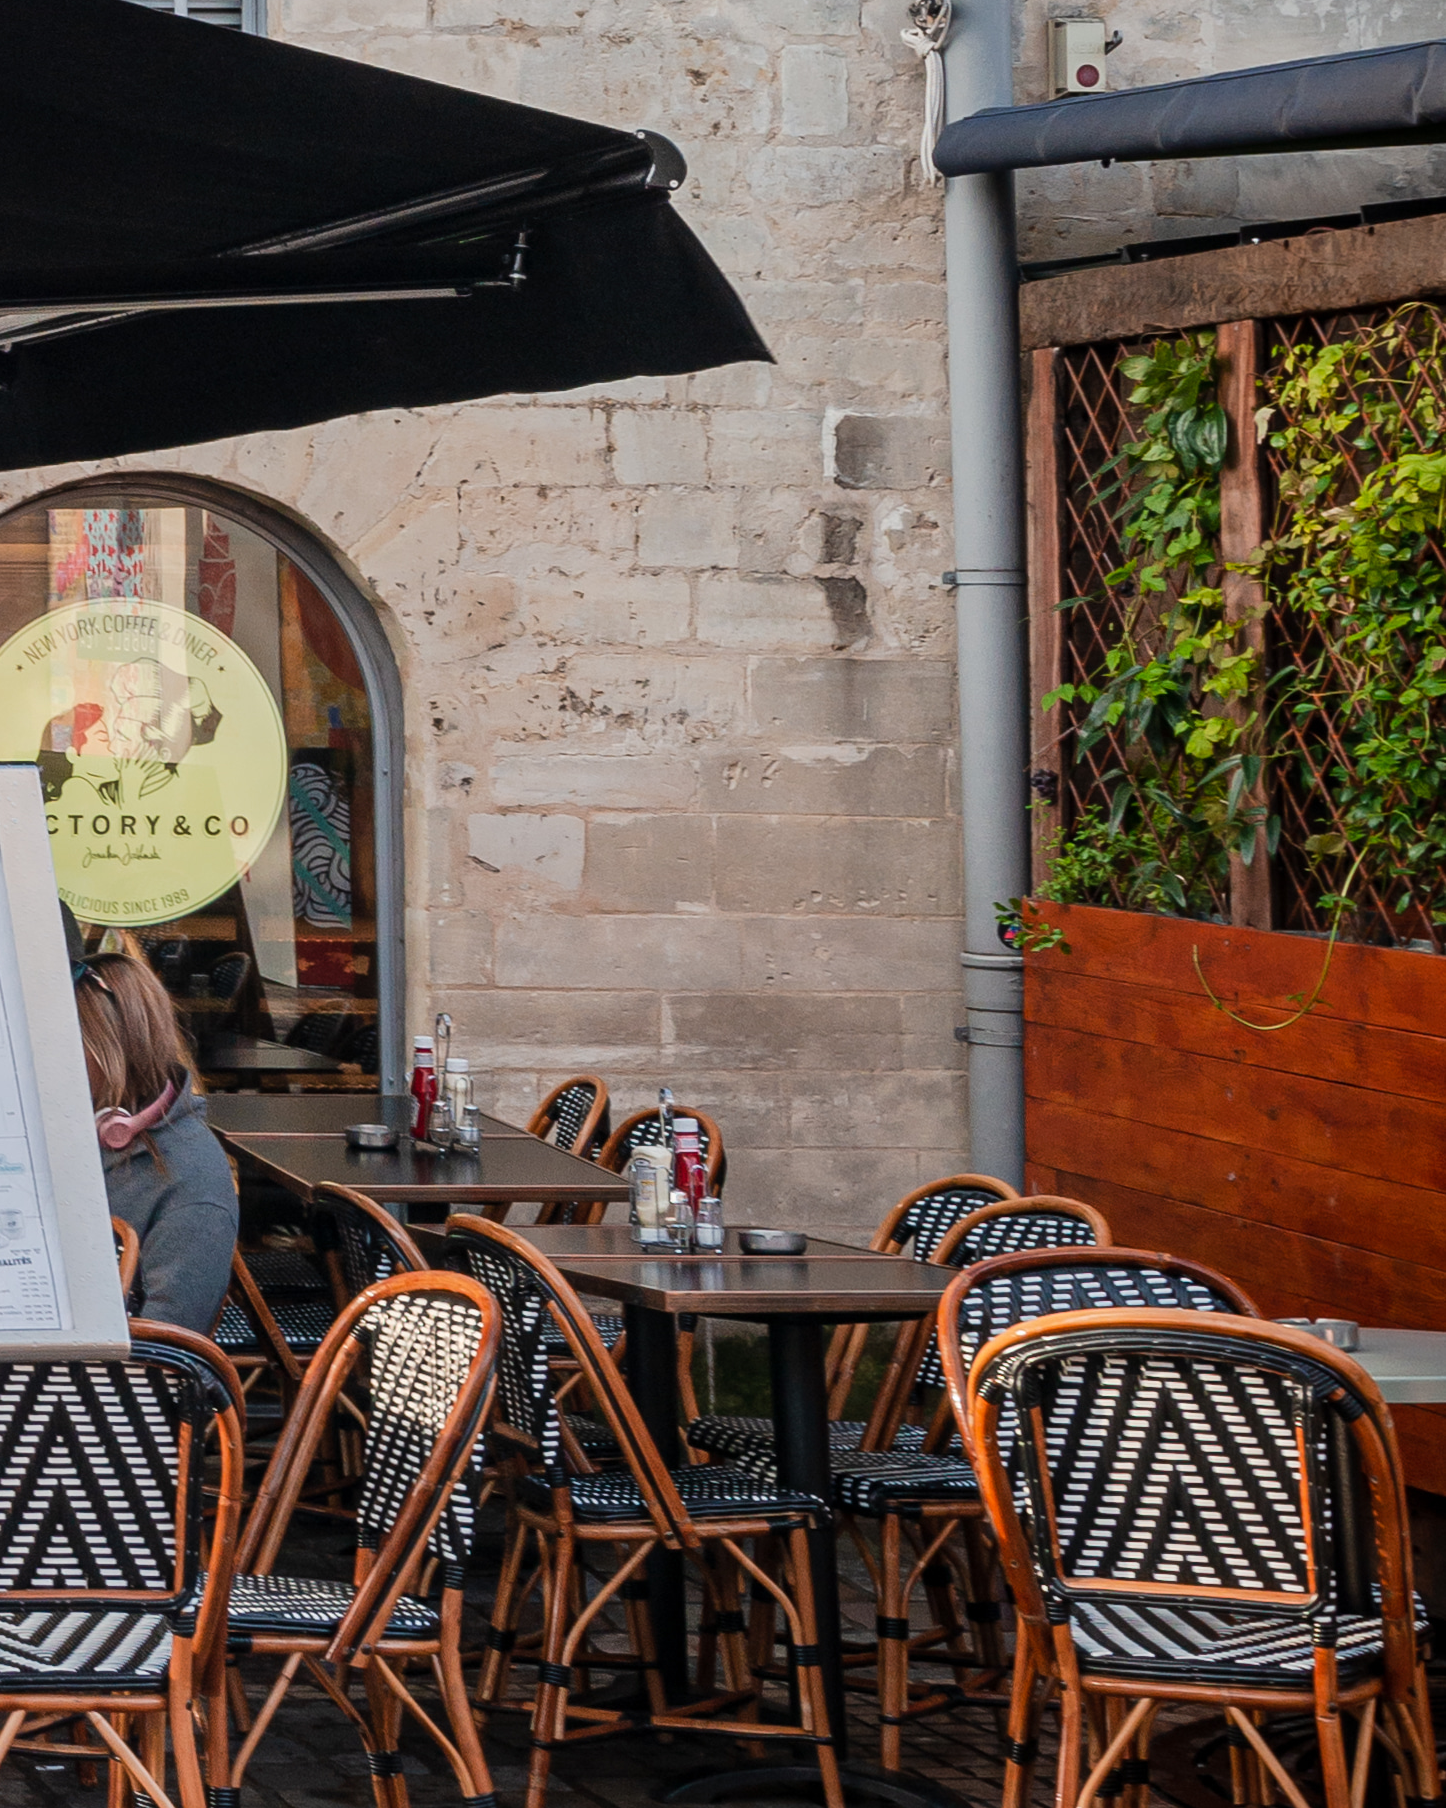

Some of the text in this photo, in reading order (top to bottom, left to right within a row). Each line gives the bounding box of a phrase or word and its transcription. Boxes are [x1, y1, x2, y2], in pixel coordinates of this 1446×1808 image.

[22, 614, 218, 666] NEW YORK COFFEE & DINER
[46, 814, 249, 837] CTORY & CO
[123, 898, 157, 915] SINCE
[161, 888, 190, 909] 1989
